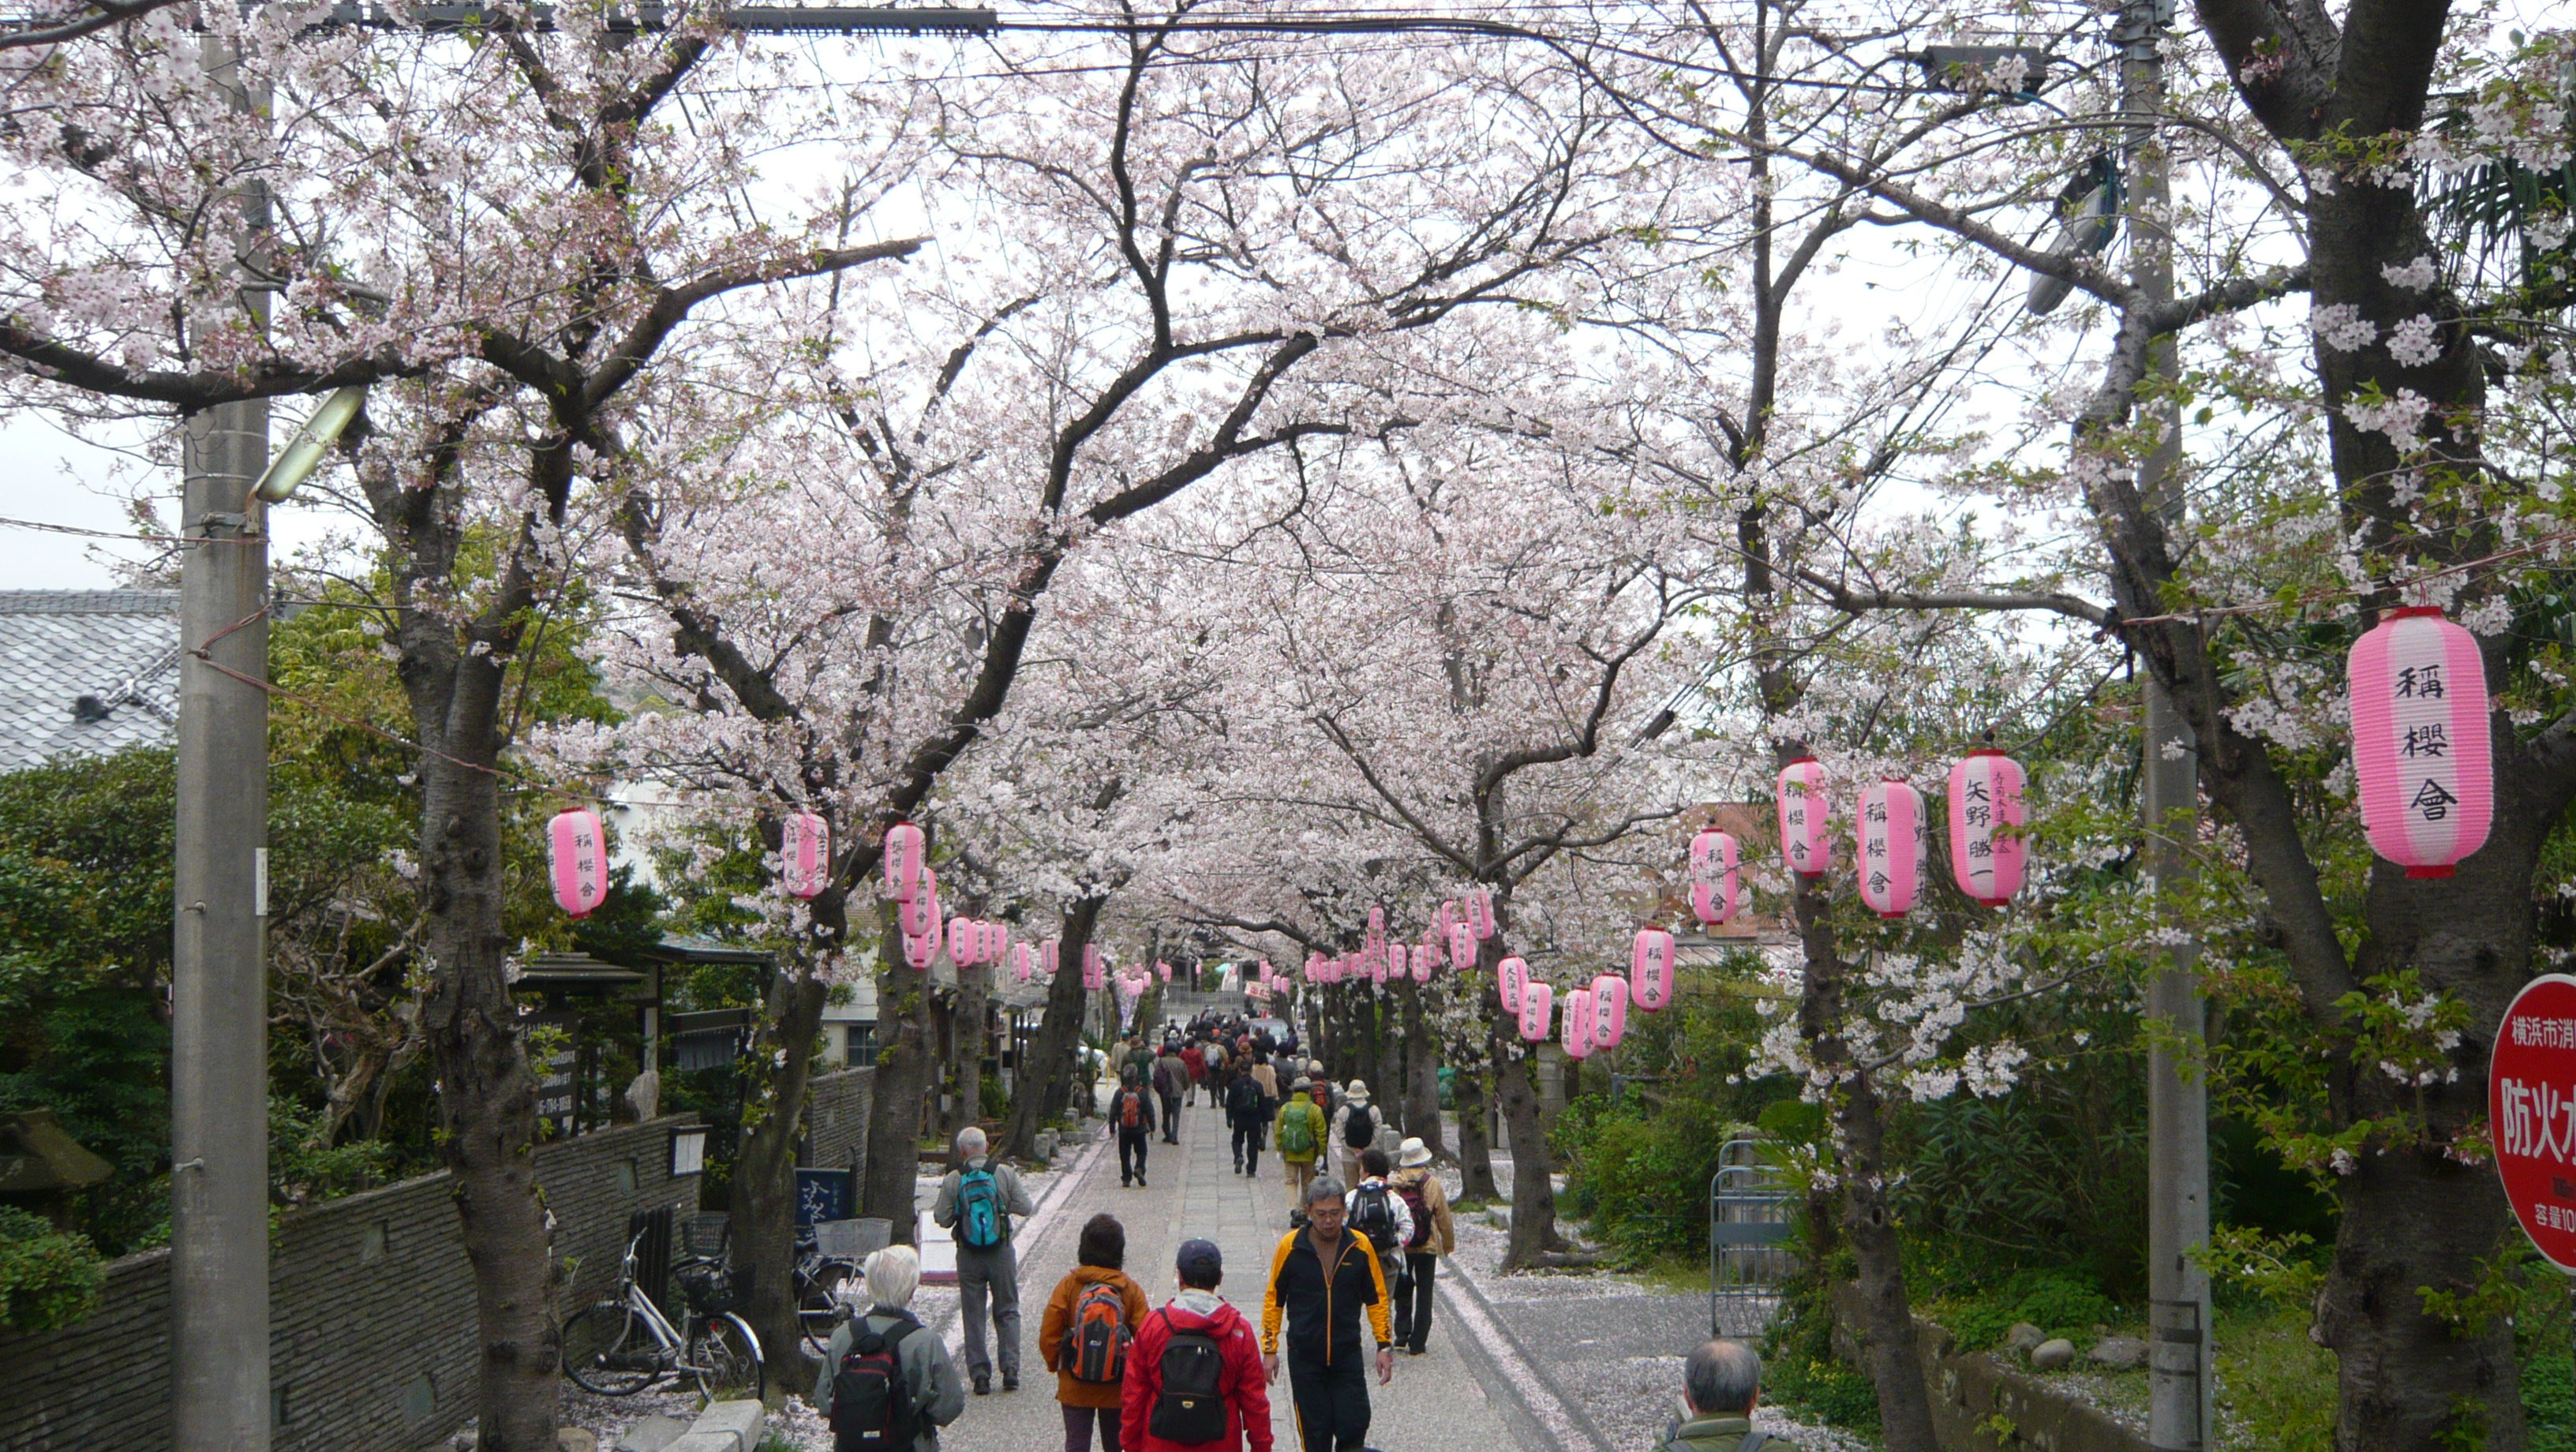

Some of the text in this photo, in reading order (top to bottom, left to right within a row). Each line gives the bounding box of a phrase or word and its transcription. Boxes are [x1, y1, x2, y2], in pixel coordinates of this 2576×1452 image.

[1965, 779, 1994, 877] 矢野勝一
[2511, 1015, 2576, 1050] 横浜市消
[2534, 1202, 2576, 1233] 容量10
